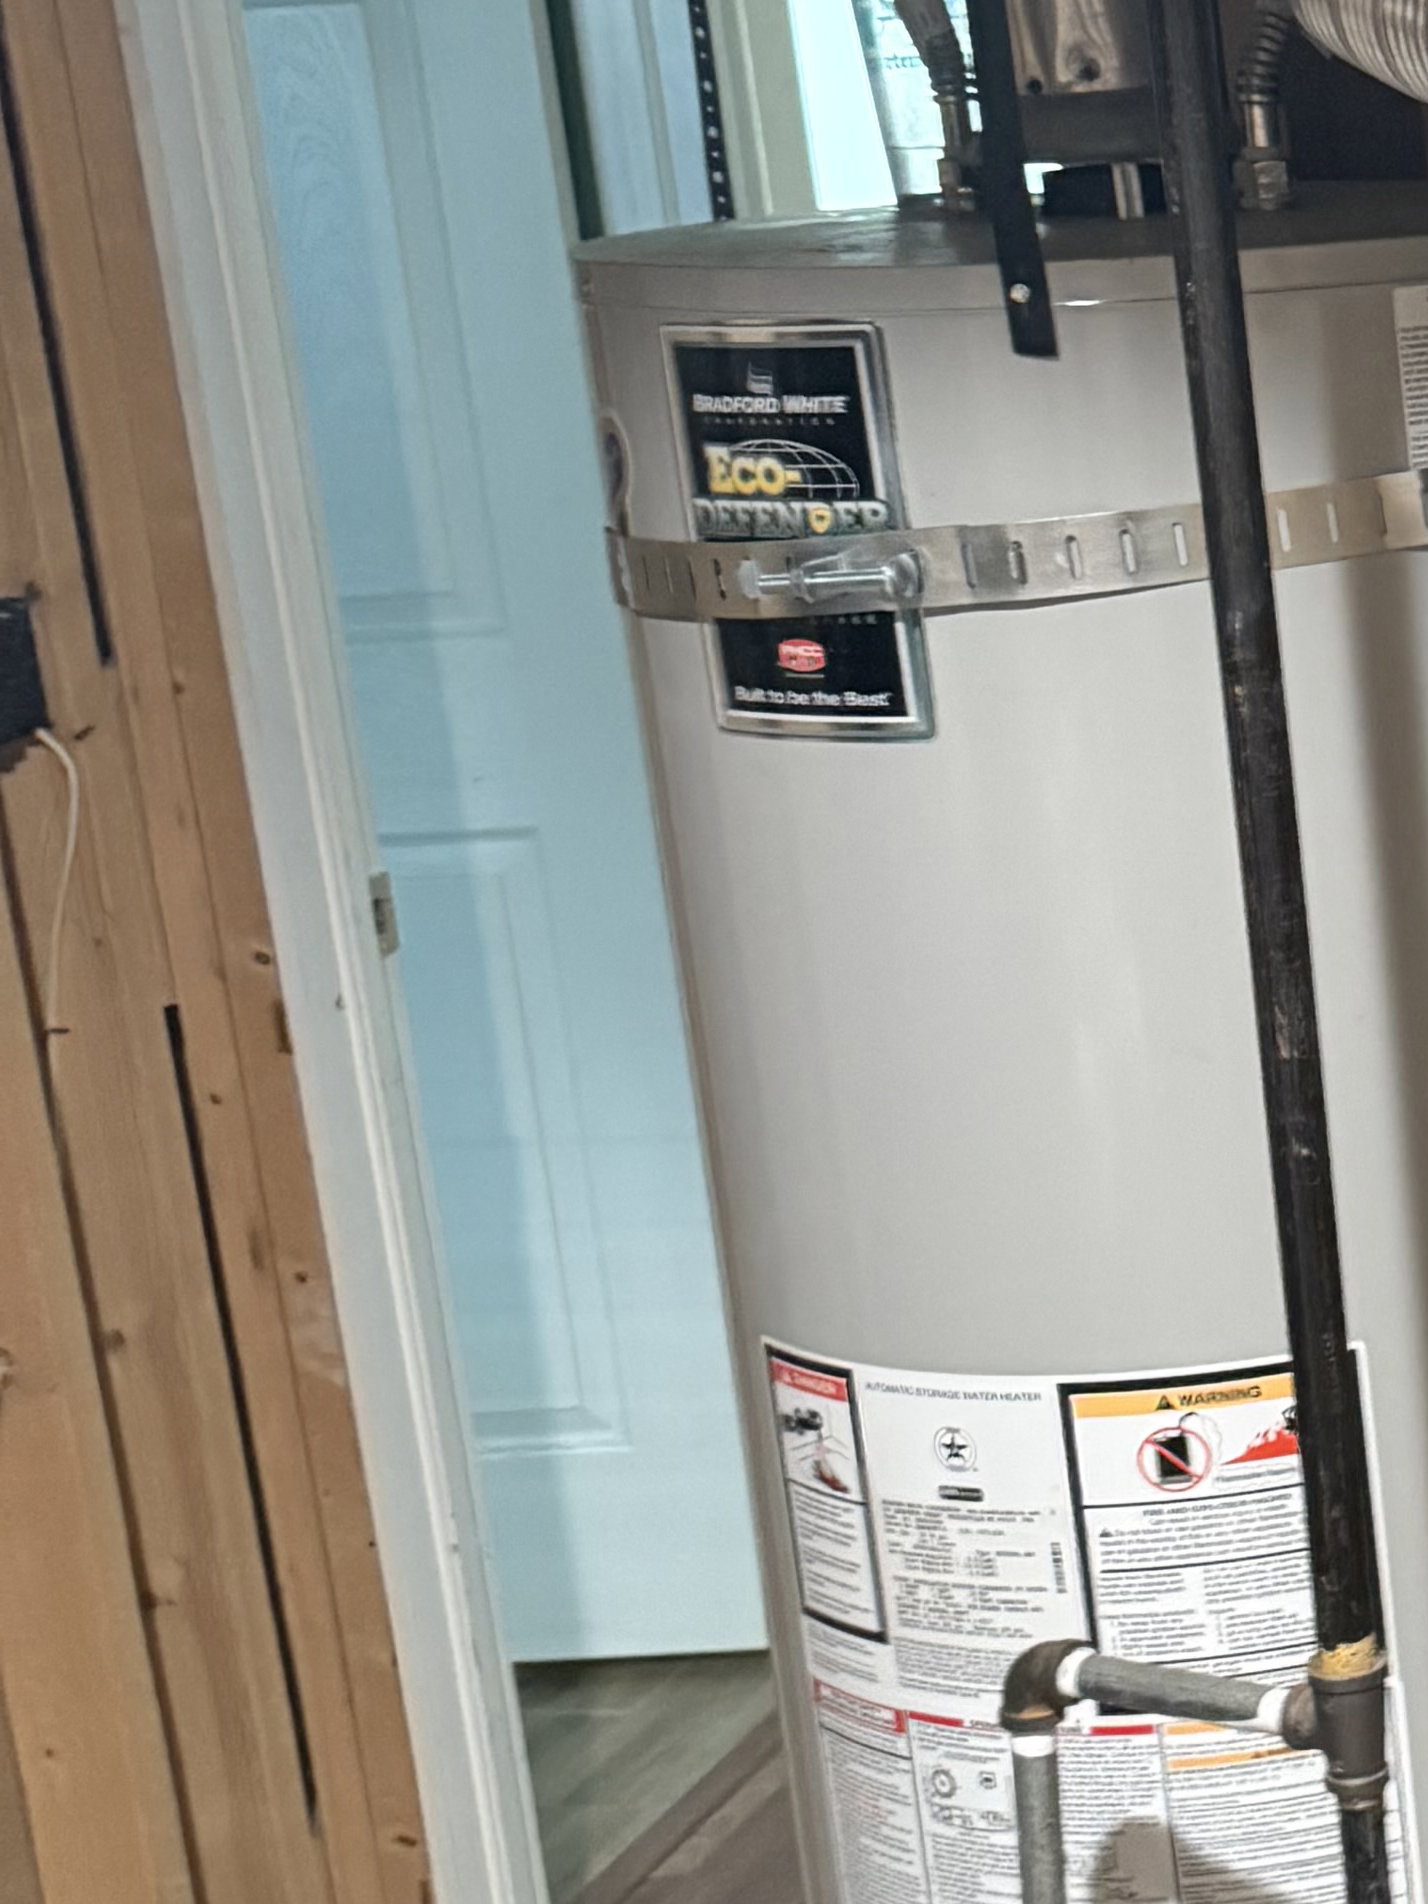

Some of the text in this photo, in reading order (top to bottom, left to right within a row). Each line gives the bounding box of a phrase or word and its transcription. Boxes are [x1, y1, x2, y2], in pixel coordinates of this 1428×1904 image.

[693, 394, 849, 414] BRADFORD WHITE
[692, 498, 888, 539] DEFENDER
[734, 685, 891, 707] Built to be the Best
[864, 1381, 1043, 1403] AUTOMATIC STORAGE WATER HEATER
[1178, 1385, 1263, 1407] WARNING
